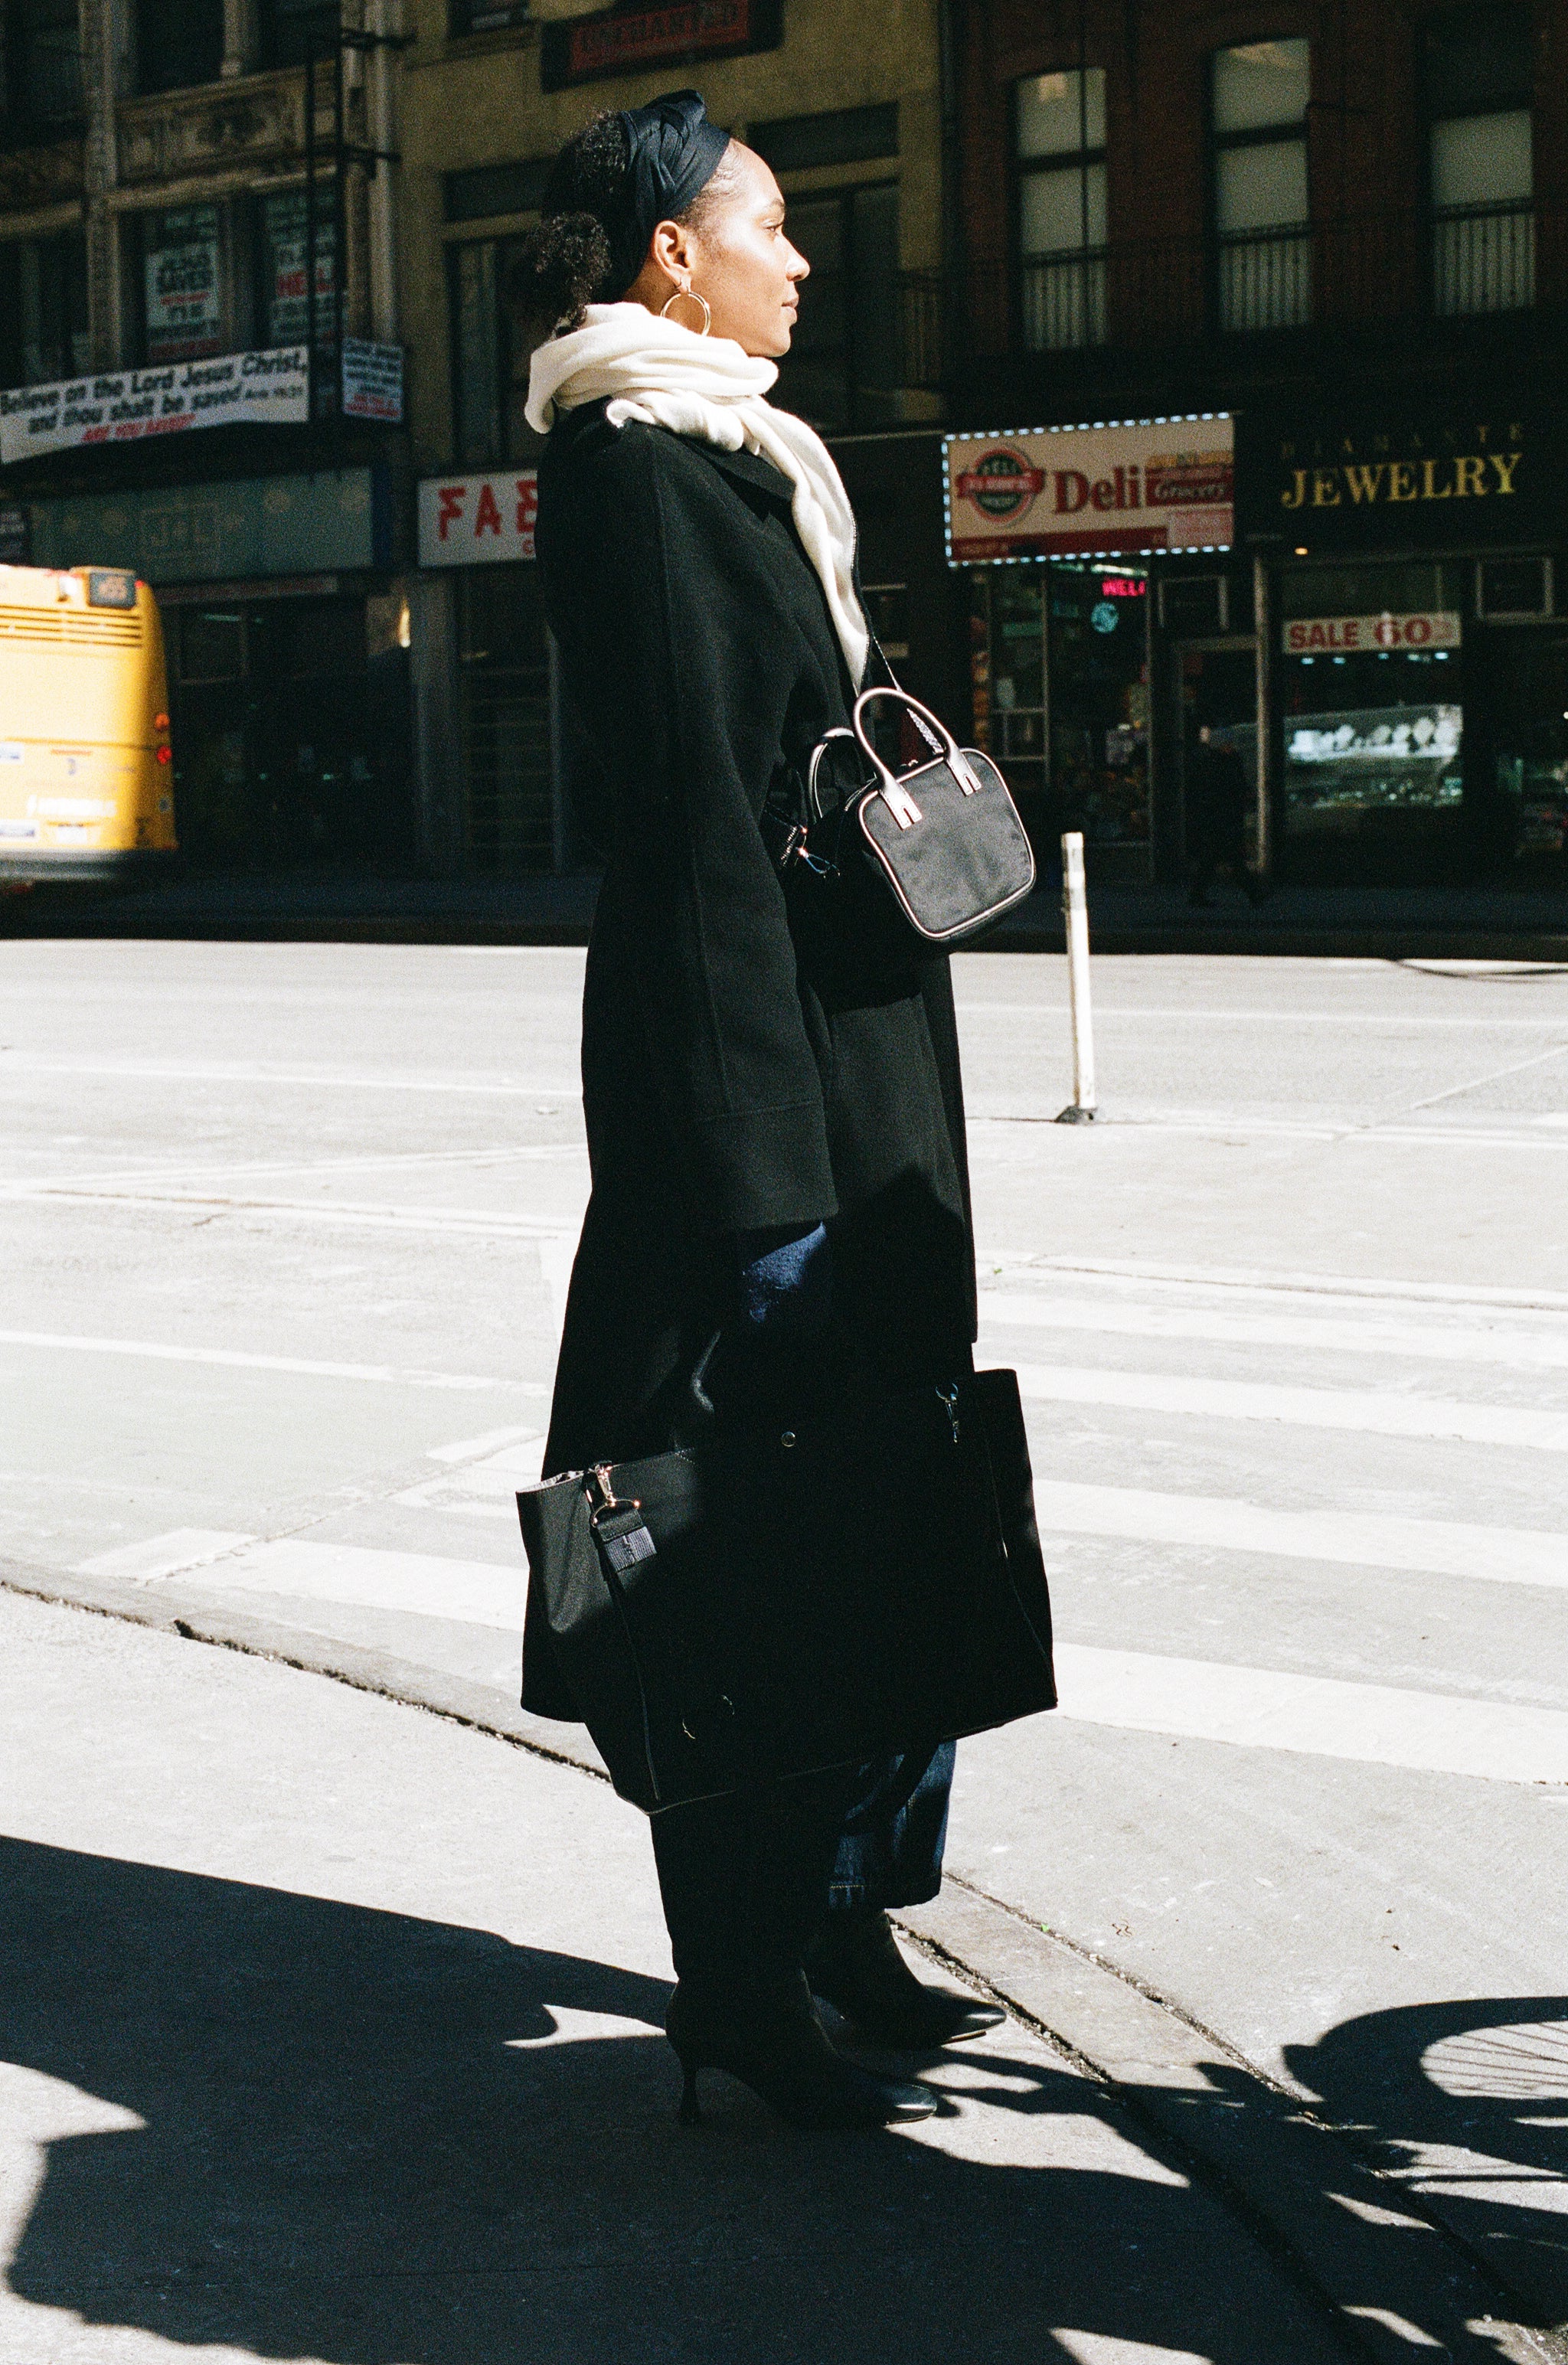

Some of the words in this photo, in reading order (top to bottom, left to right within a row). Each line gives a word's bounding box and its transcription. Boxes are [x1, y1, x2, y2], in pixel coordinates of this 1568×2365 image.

[132, 371, 175, 394] Lord
[180, 364, 234, 387] Jesus
[161, 394, 185, 414] be
[1054, 464, 1141, 514] Deli
[1280, 452, 1524, 509] JEWELRY
[1289, 620, 1358, 649] SALE
